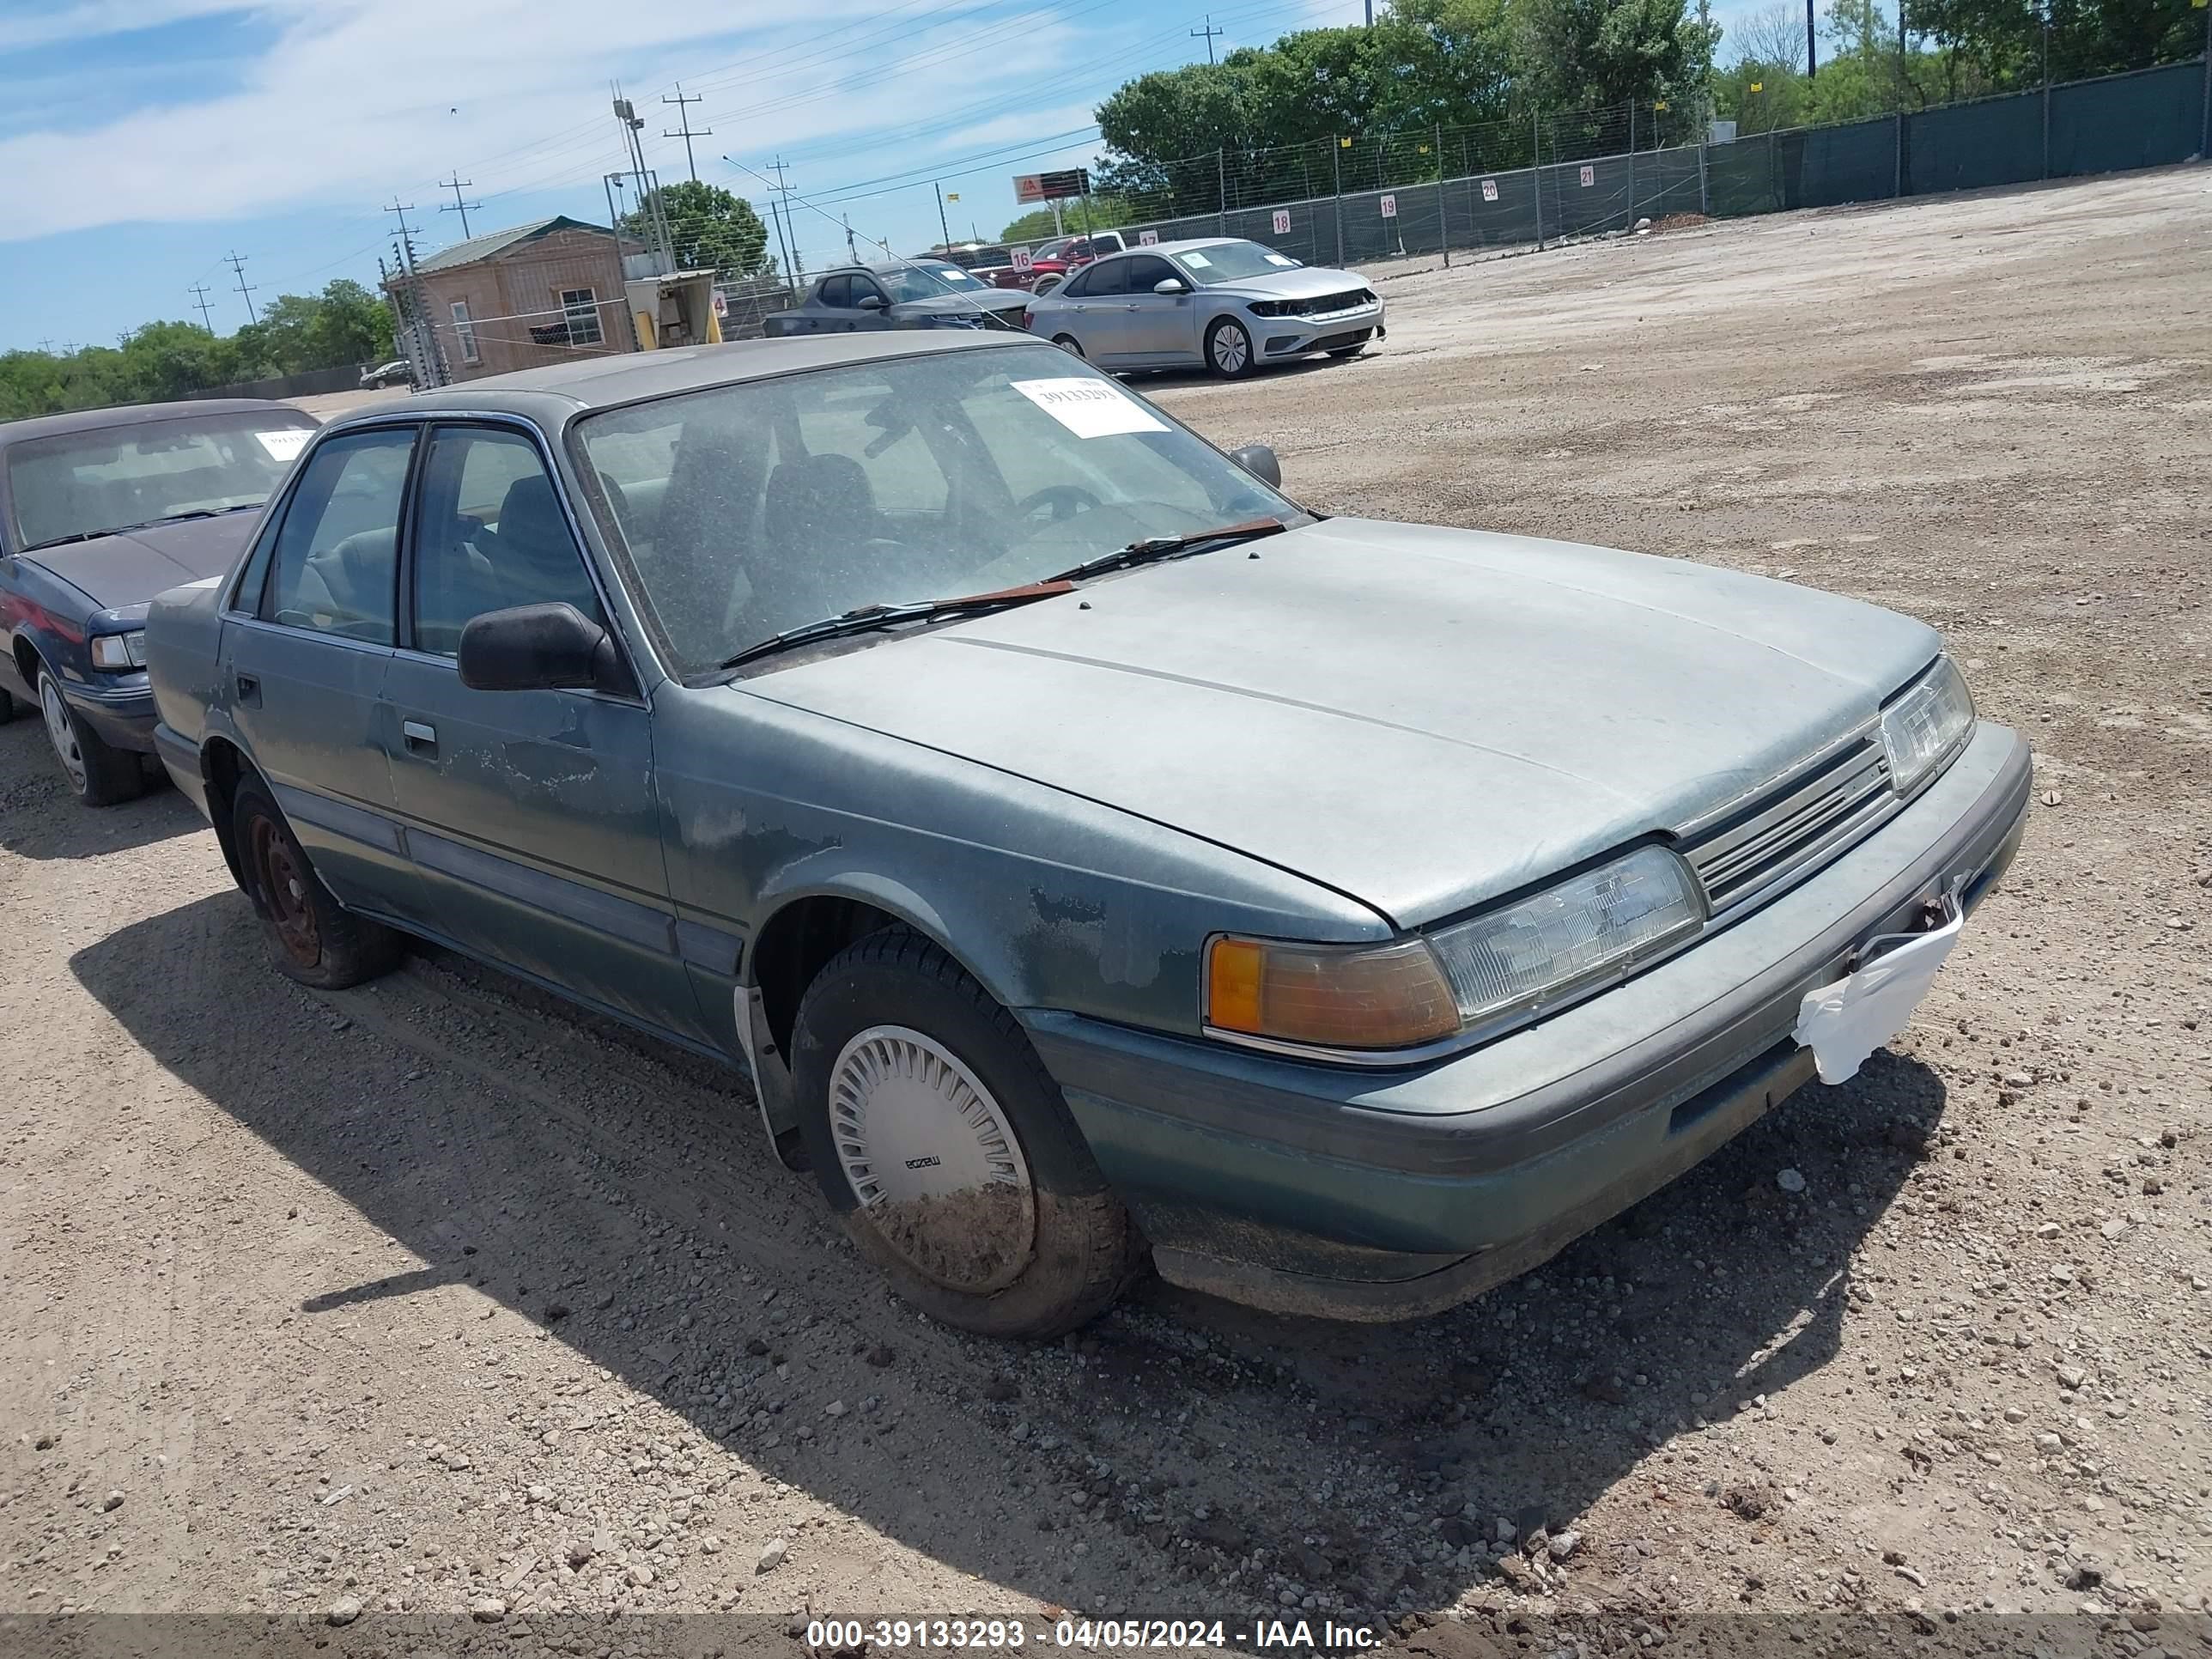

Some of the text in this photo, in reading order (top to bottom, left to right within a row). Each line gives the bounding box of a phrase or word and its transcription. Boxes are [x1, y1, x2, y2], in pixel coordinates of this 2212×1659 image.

[1582, 171, 1592, 183] 21
[1483, 185, 1496, 198] 20
[1382, 200, 1395, 214] 19
[1275, 216, 1288, 230] 18
[1142, 236, 1156, 246] 17
[1013, 252, 1029, 267] 16
[1037, 390, 1117, 404] 39133293
[905, 1156, 941, 1170] mazda
